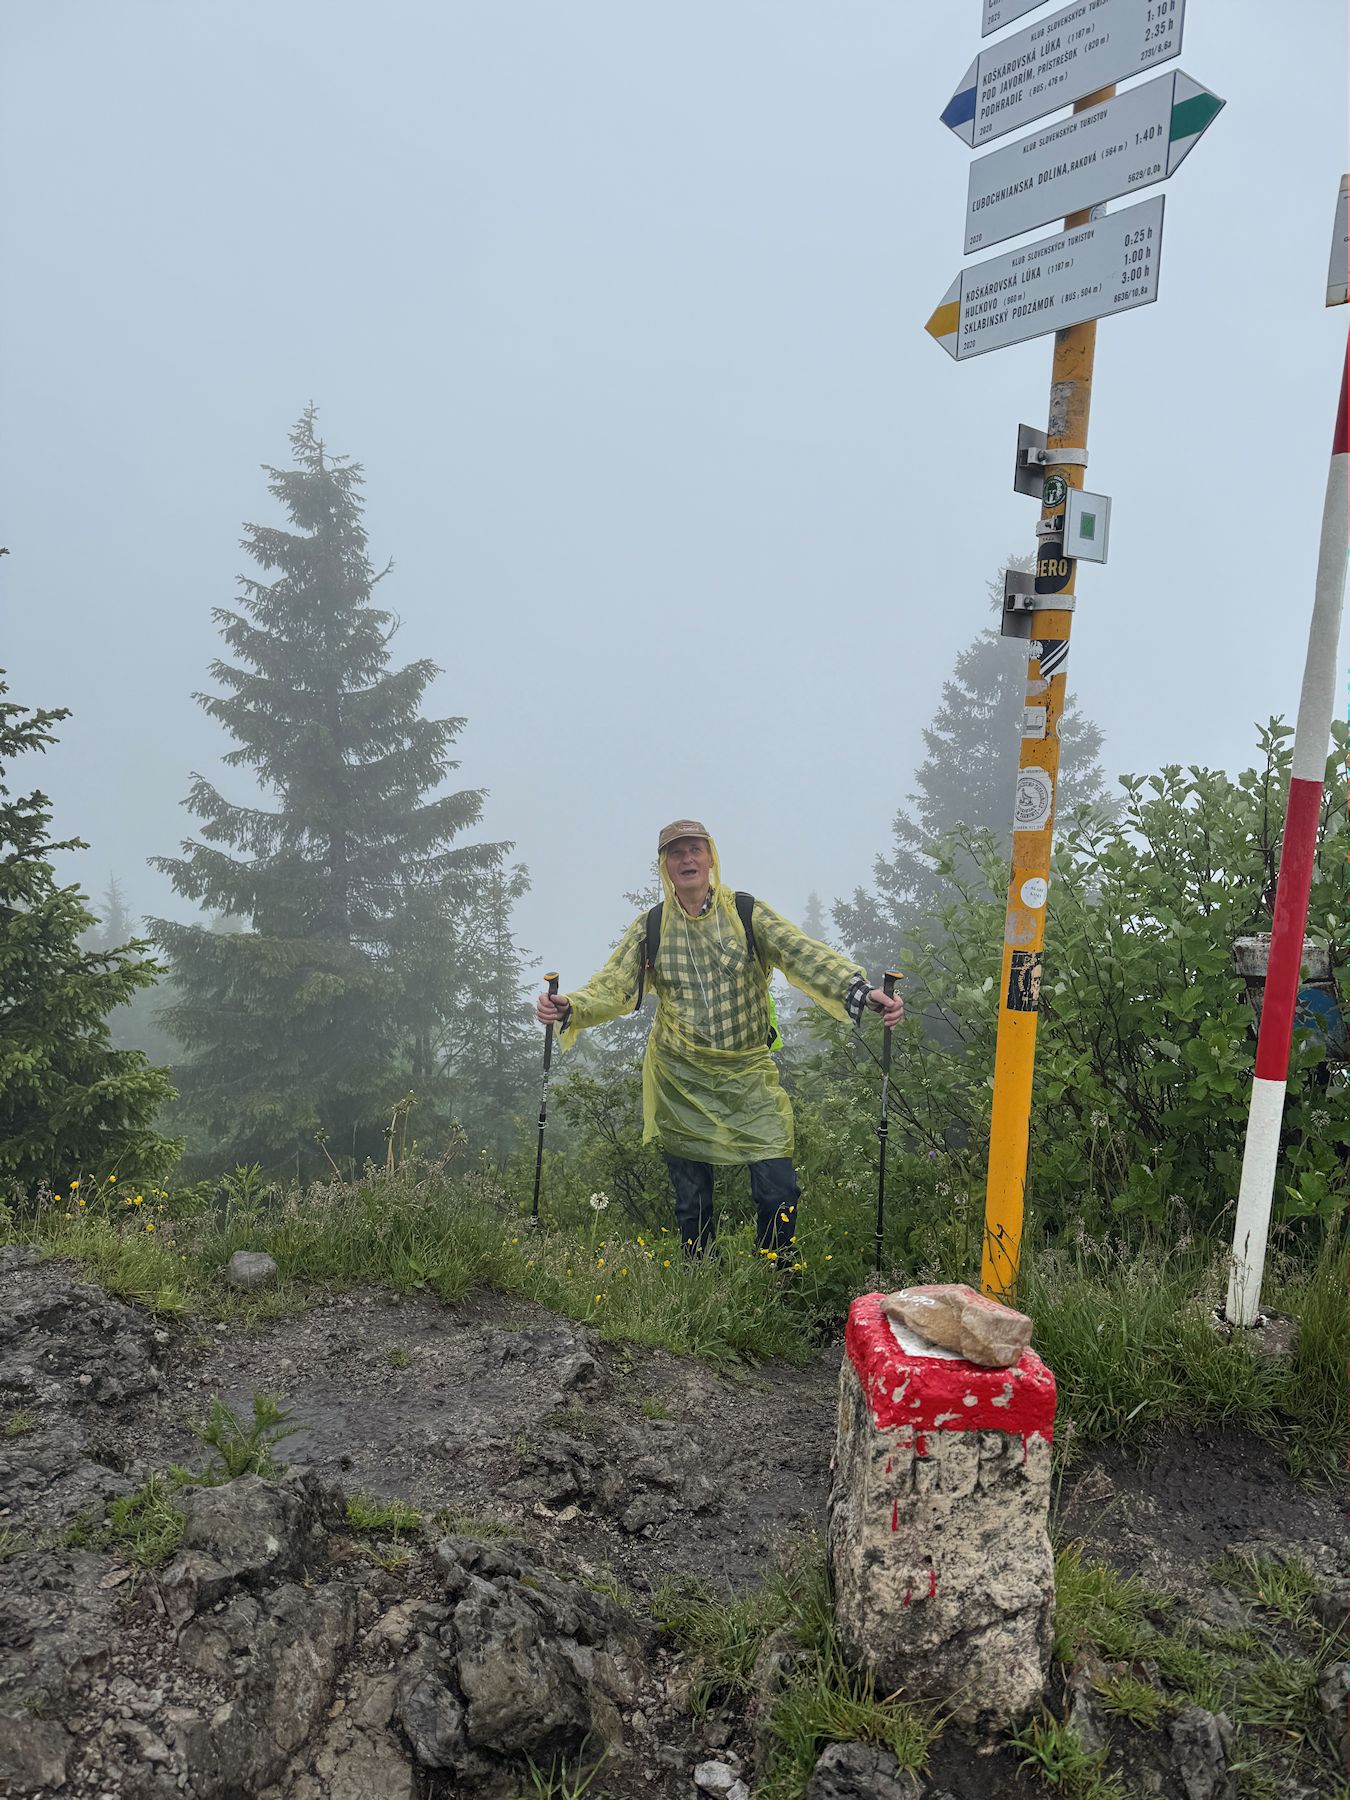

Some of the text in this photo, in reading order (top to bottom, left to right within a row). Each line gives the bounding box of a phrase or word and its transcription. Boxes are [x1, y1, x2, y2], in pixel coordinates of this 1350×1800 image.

[1030, 28, 1045, 42] KLUB
[1047, 6, 1086, 34] SLOVENSKÝCH
[1145, 18, 1174, 42] 2:35 h
[983, 48, 1036, 87] KOŠKÁROVSKÁ
[1040, 38, 1061, 58] LÚKA
[982, 86, 997, 103] POD
[1000, 68, 1035, 95] JAVORÍM,
[1037, 48, 1078, 76] PRÍSTREŠOK
[980, 90, 1023, 120] PODHRADIE
[979, 124, 993, 136] 2020
[1023, 110, 1108, 154] KLUB SLOVENSKÝCH TURISTOV
[1135, 124, 1163, 145] 1:40 h
[972, 176, 1034, 213] ĽUBOCHNIANSKA
[970, 233, 982, 245] 2020
[1012, 230, 1095, 267] KLUB SLOVENSKÝCH TURISTOV
[1124, 227, 1153, 247] 0:25 h
[1124, 247, 1151, 266] 1:00 h
[966, 273, 1017, 303] KOŠKÁROVSKÁ
[1021, 266, 1041, 283] LÚKA
[1122, 266, 1150, 284] 3:00 h
[964, 310, 1009, 335] SKLABINSKÝ
[1012, 295, 1055, 320] PODZÁMOK
[965, 297, 998, 318] HUĽKOVO
[964, 340, 976, 350] 2020
[1036, 558, 1068, 578] HERO
